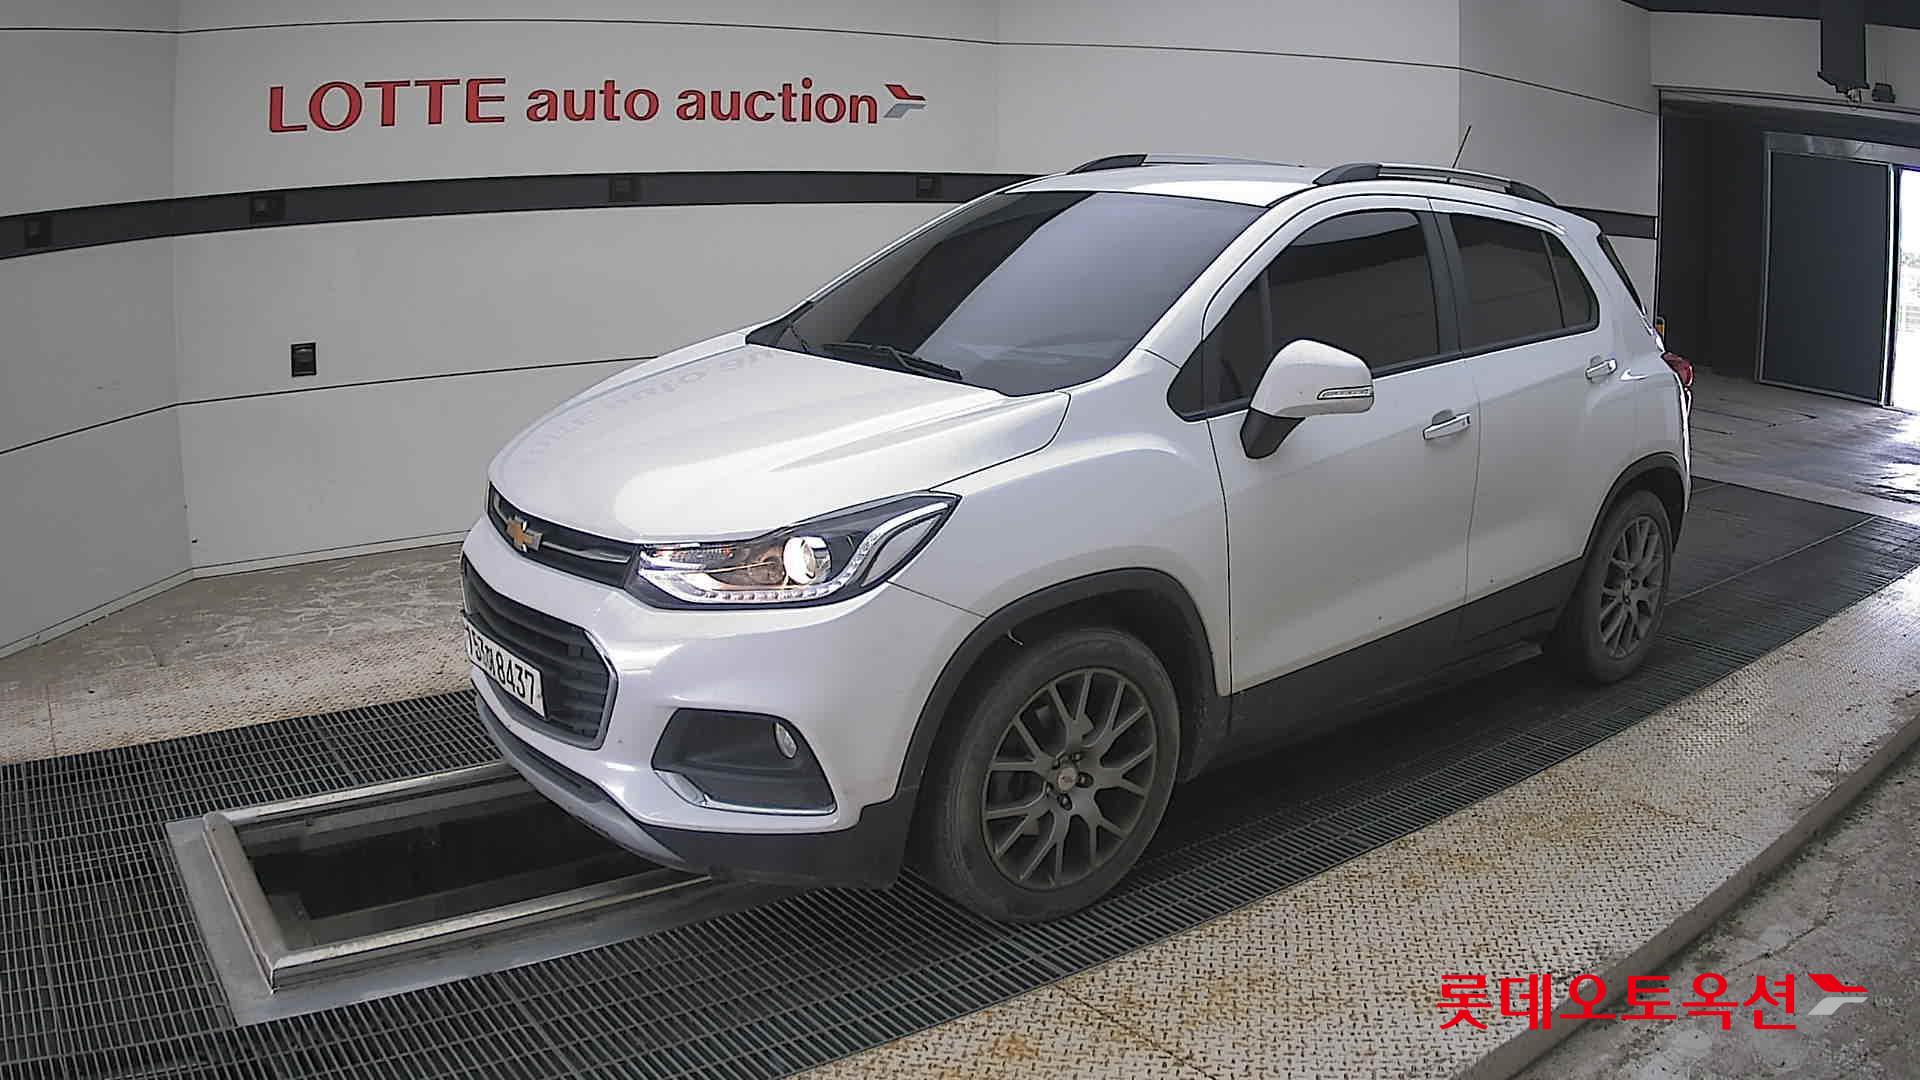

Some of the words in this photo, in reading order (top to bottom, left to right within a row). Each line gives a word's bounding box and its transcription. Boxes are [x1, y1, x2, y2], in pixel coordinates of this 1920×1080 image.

[269, 78, 506, 133] LOTTE
[526, 80, 659, 122] auto
[676, 78, 878, 125] auction
